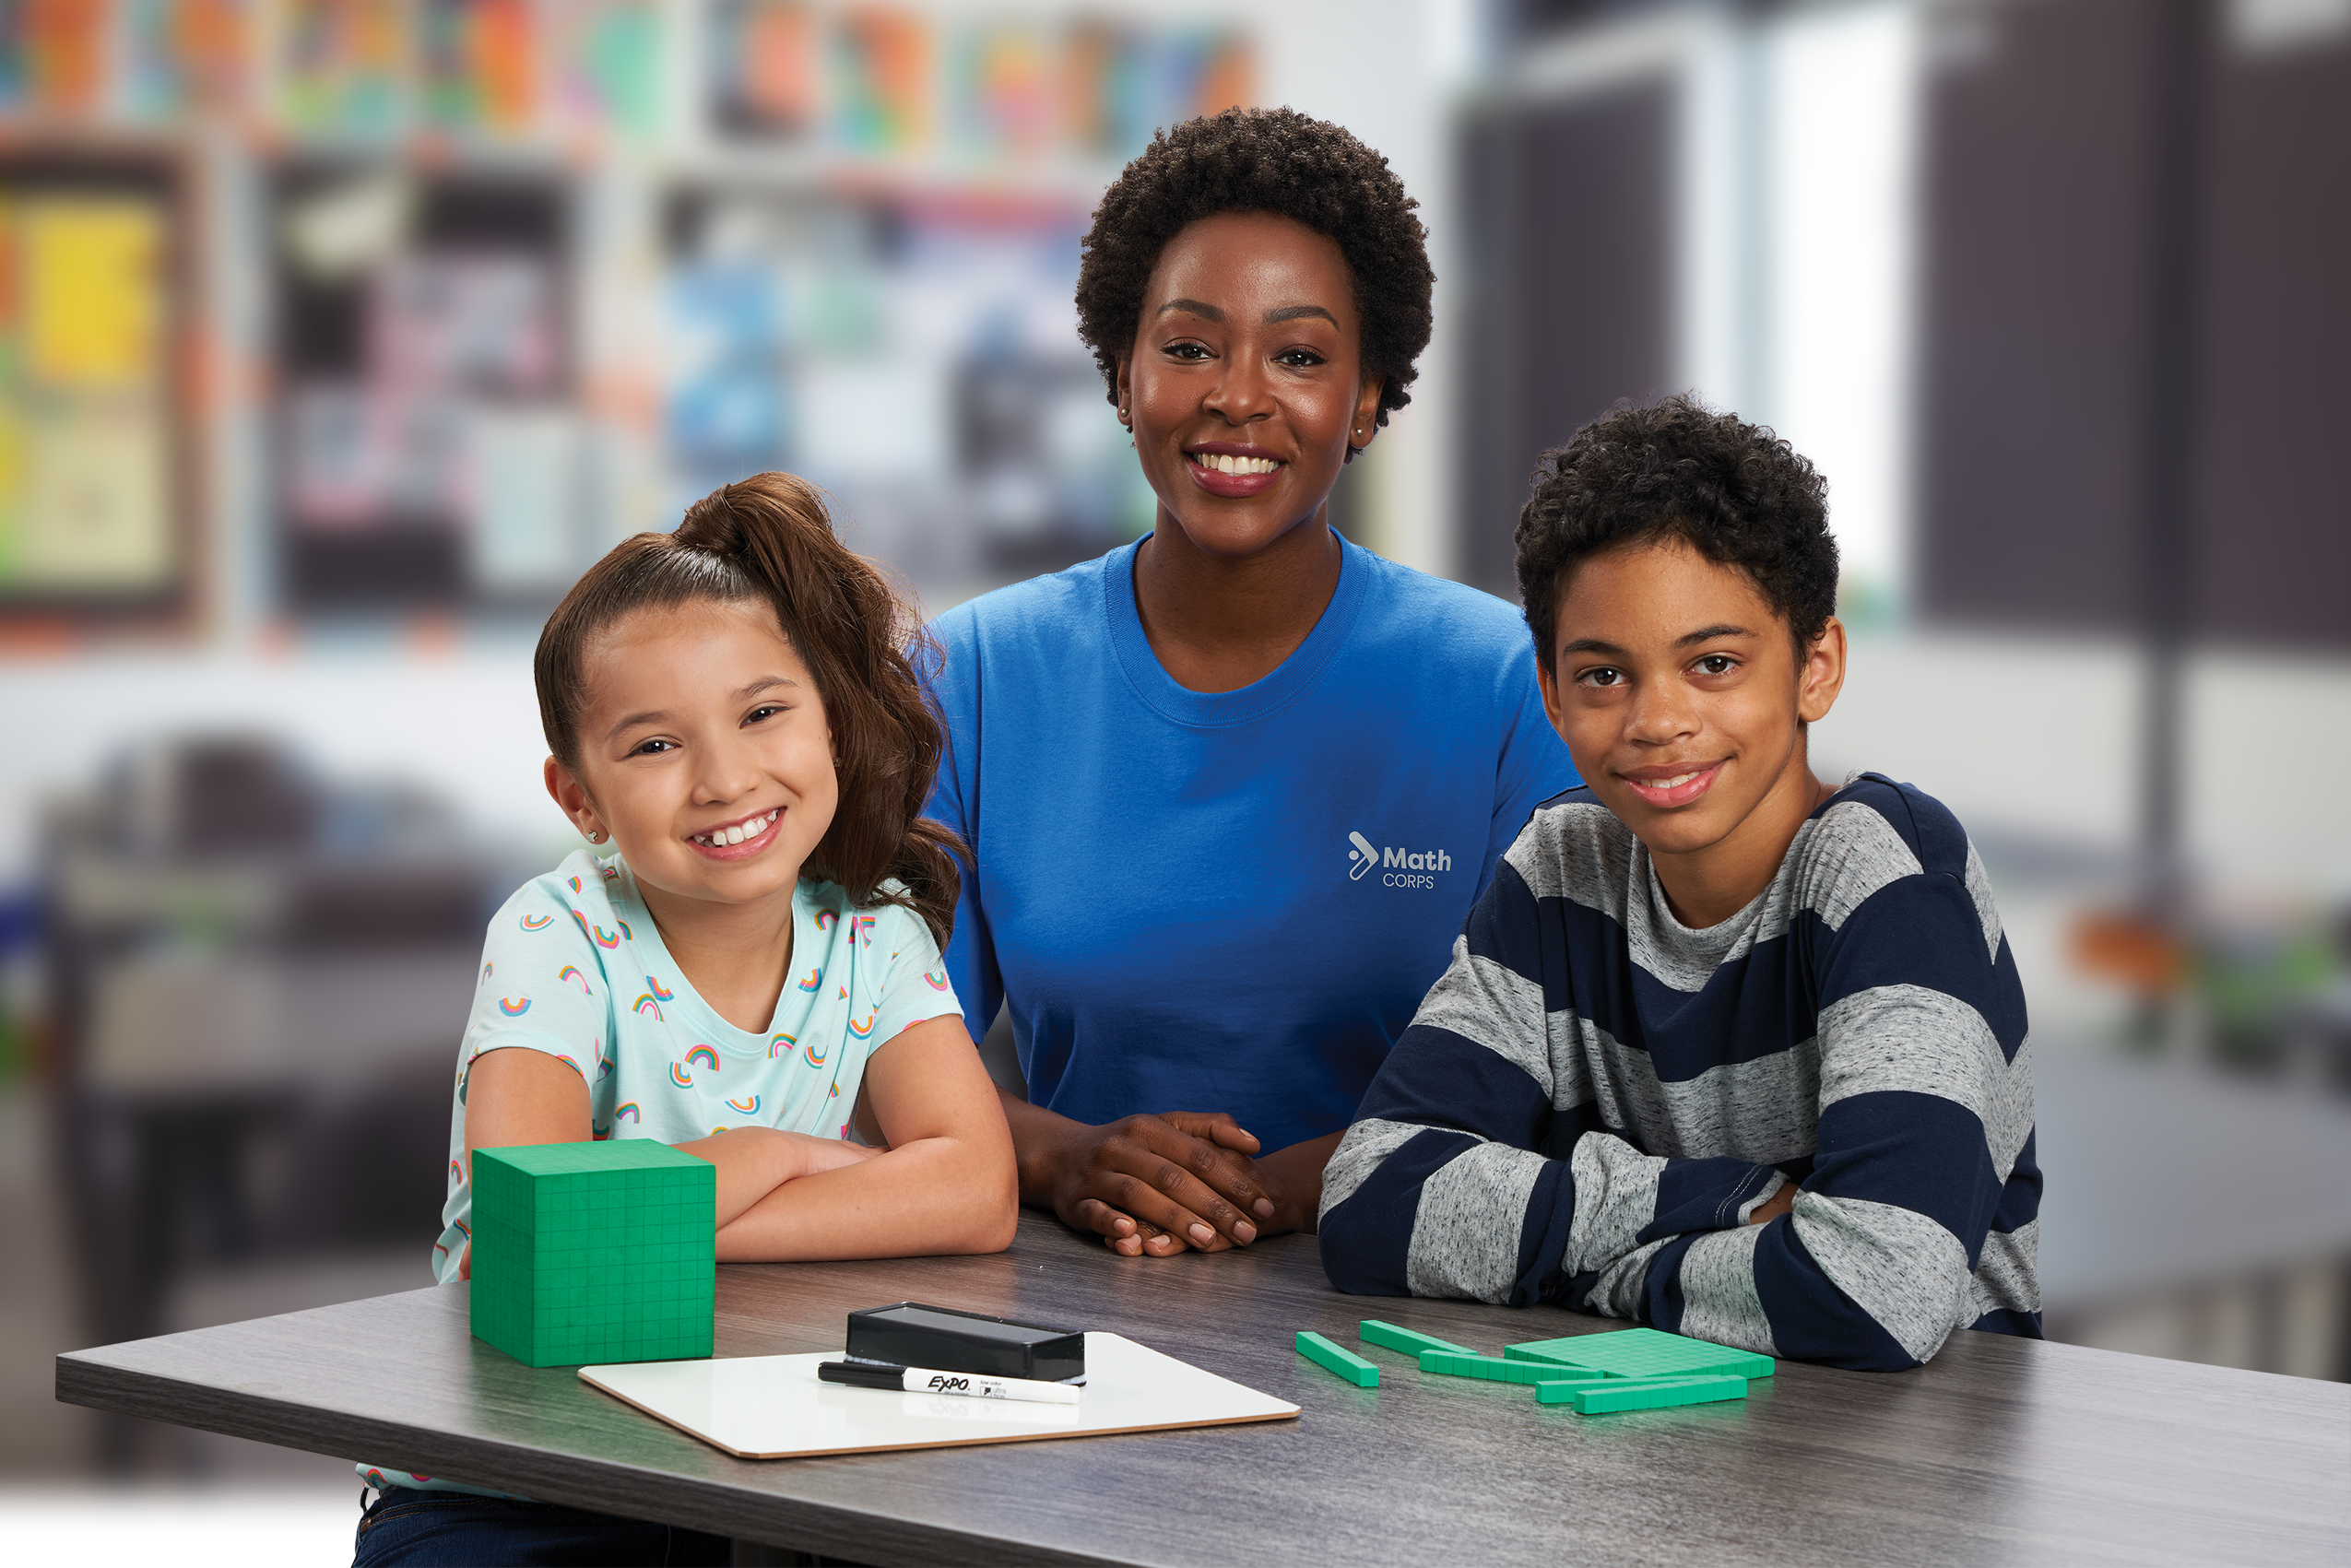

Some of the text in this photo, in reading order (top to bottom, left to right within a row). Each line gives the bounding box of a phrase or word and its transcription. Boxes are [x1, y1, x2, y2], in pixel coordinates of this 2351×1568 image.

[1383, 847, 1452, 871] Math
[1383, 873, 1435, 890] CORPS
[927, 1376, 970, 1393] EXPO
